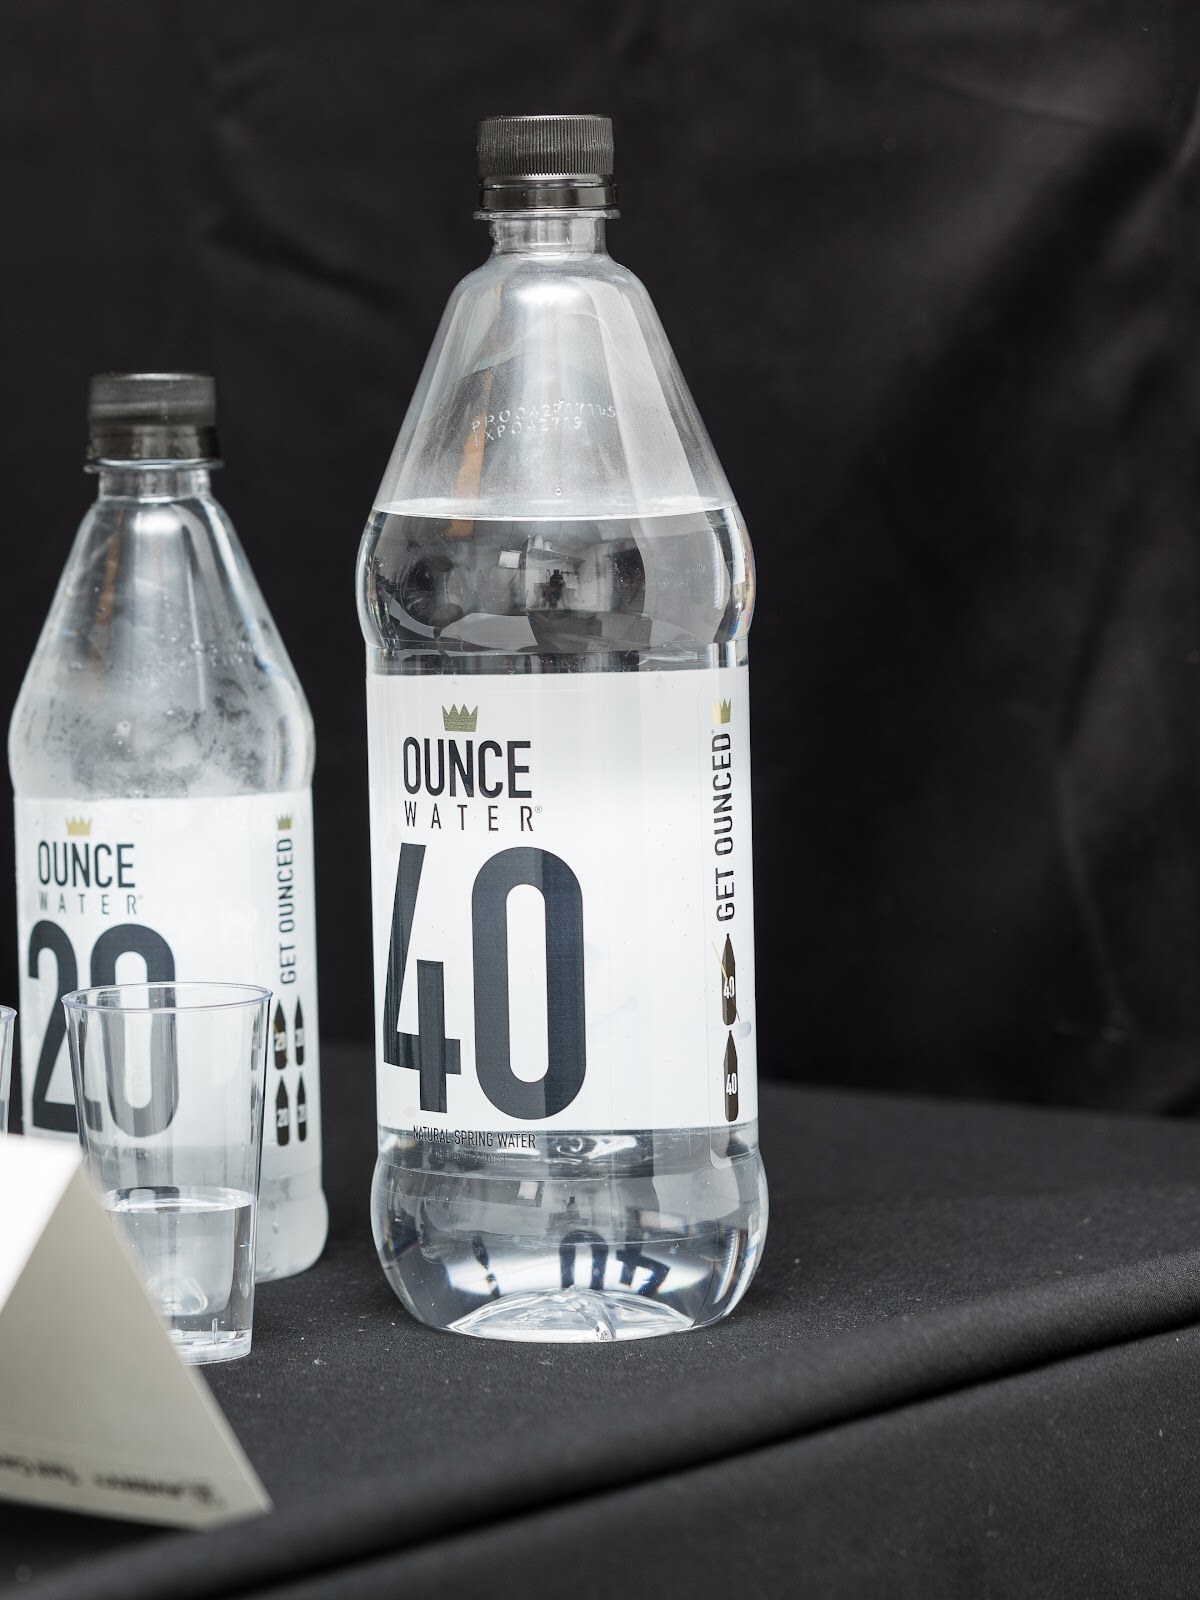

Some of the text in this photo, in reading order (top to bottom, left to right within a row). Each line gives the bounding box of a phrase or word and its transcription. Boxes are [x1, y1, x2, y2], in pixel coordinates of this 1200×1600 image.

[403, 736, 532, 798] OUNCE
[38, 840, 136, 888] OUNCE
[39, 891, 137, 915] WATER
[276, 837, 297, 985] GET OUNCED
[715, 867, 736, 923] GET
[383, 842, 587, 1120] 40
[723, 975, 736, 999] 40
[29, 919, 180, 1138] 20
[725, 1072, 738, 1096] 40
[412, 1125, 537, 1149] NATURAL SPRING WATER
